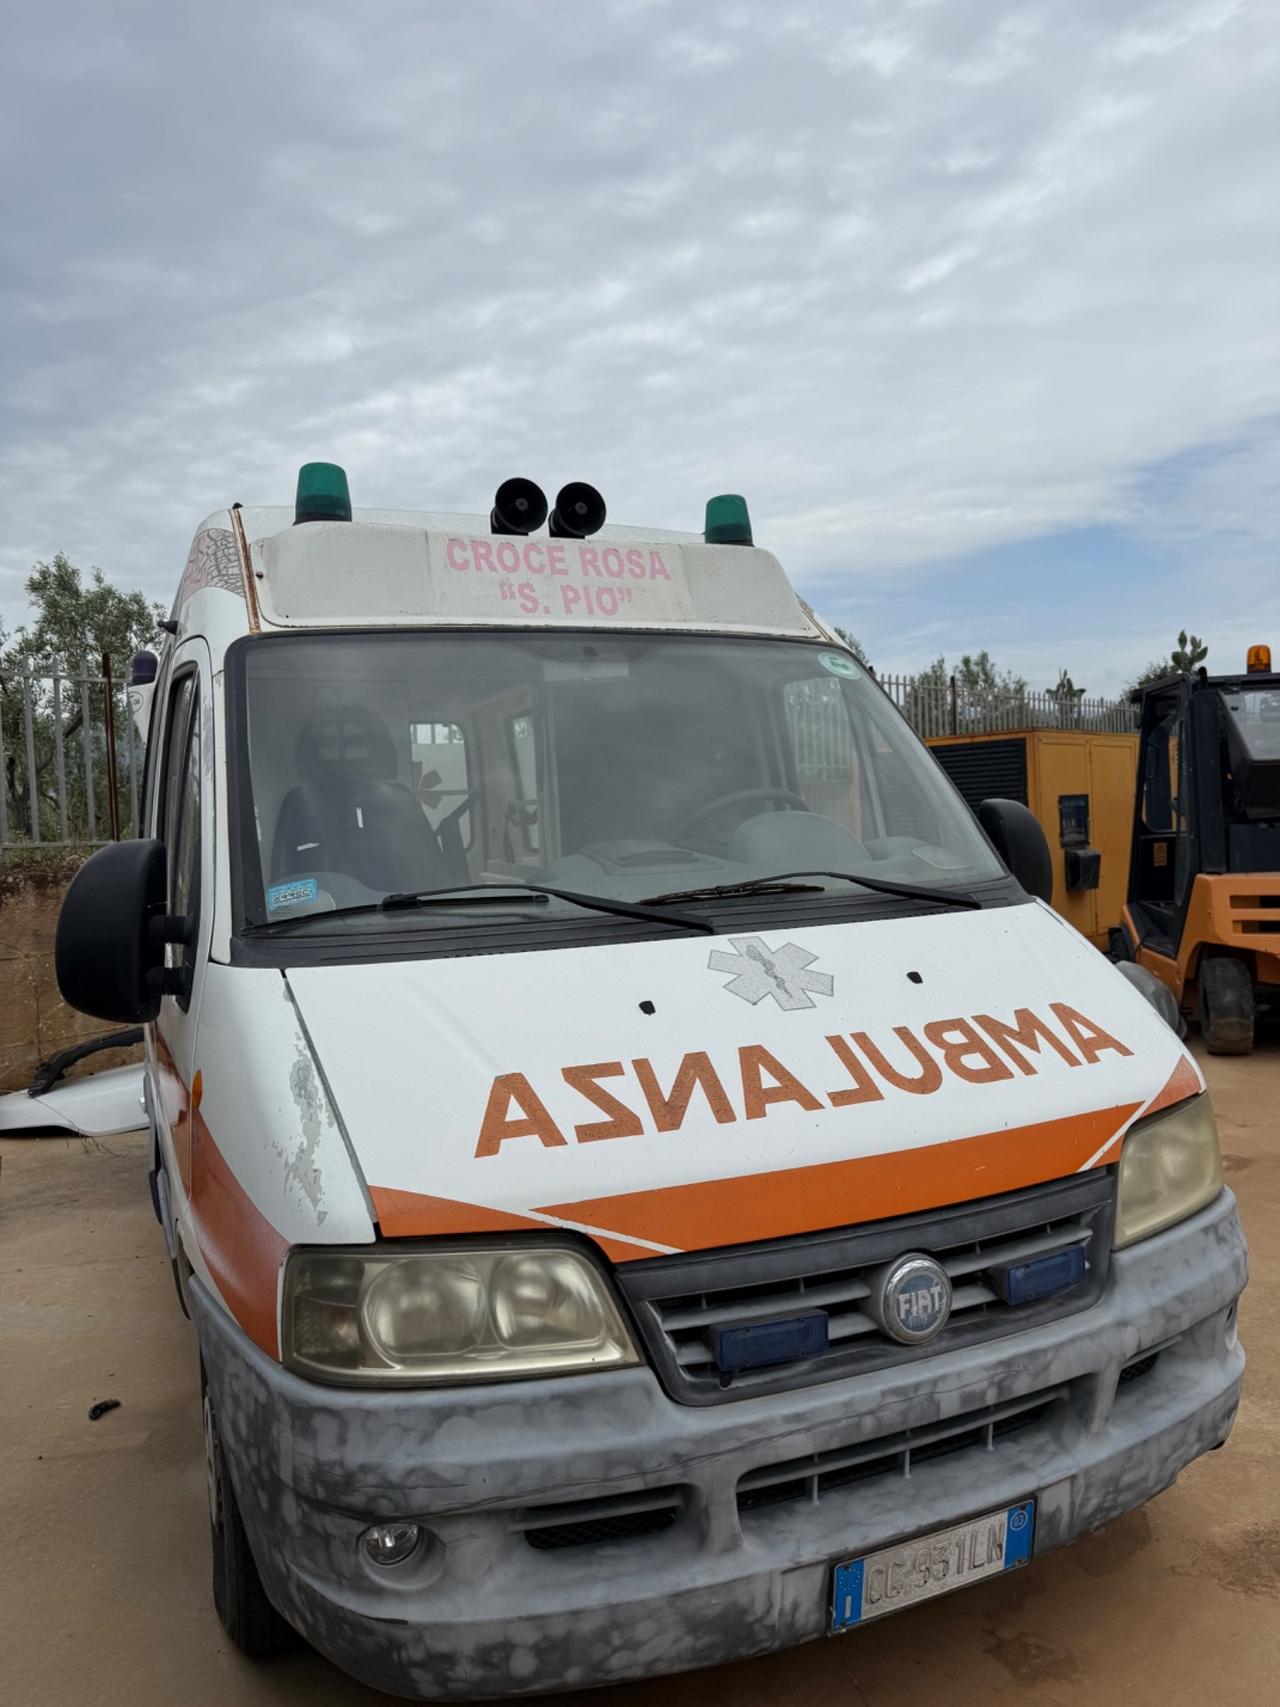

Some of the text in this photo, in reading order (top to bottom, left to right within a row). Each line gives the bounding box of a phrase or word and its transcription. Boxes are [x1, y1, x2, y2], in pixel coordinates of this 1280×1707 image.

[446, 538, 671, 581] CROCE ROSA
[898, 1285, 942, 1320] FIAT
